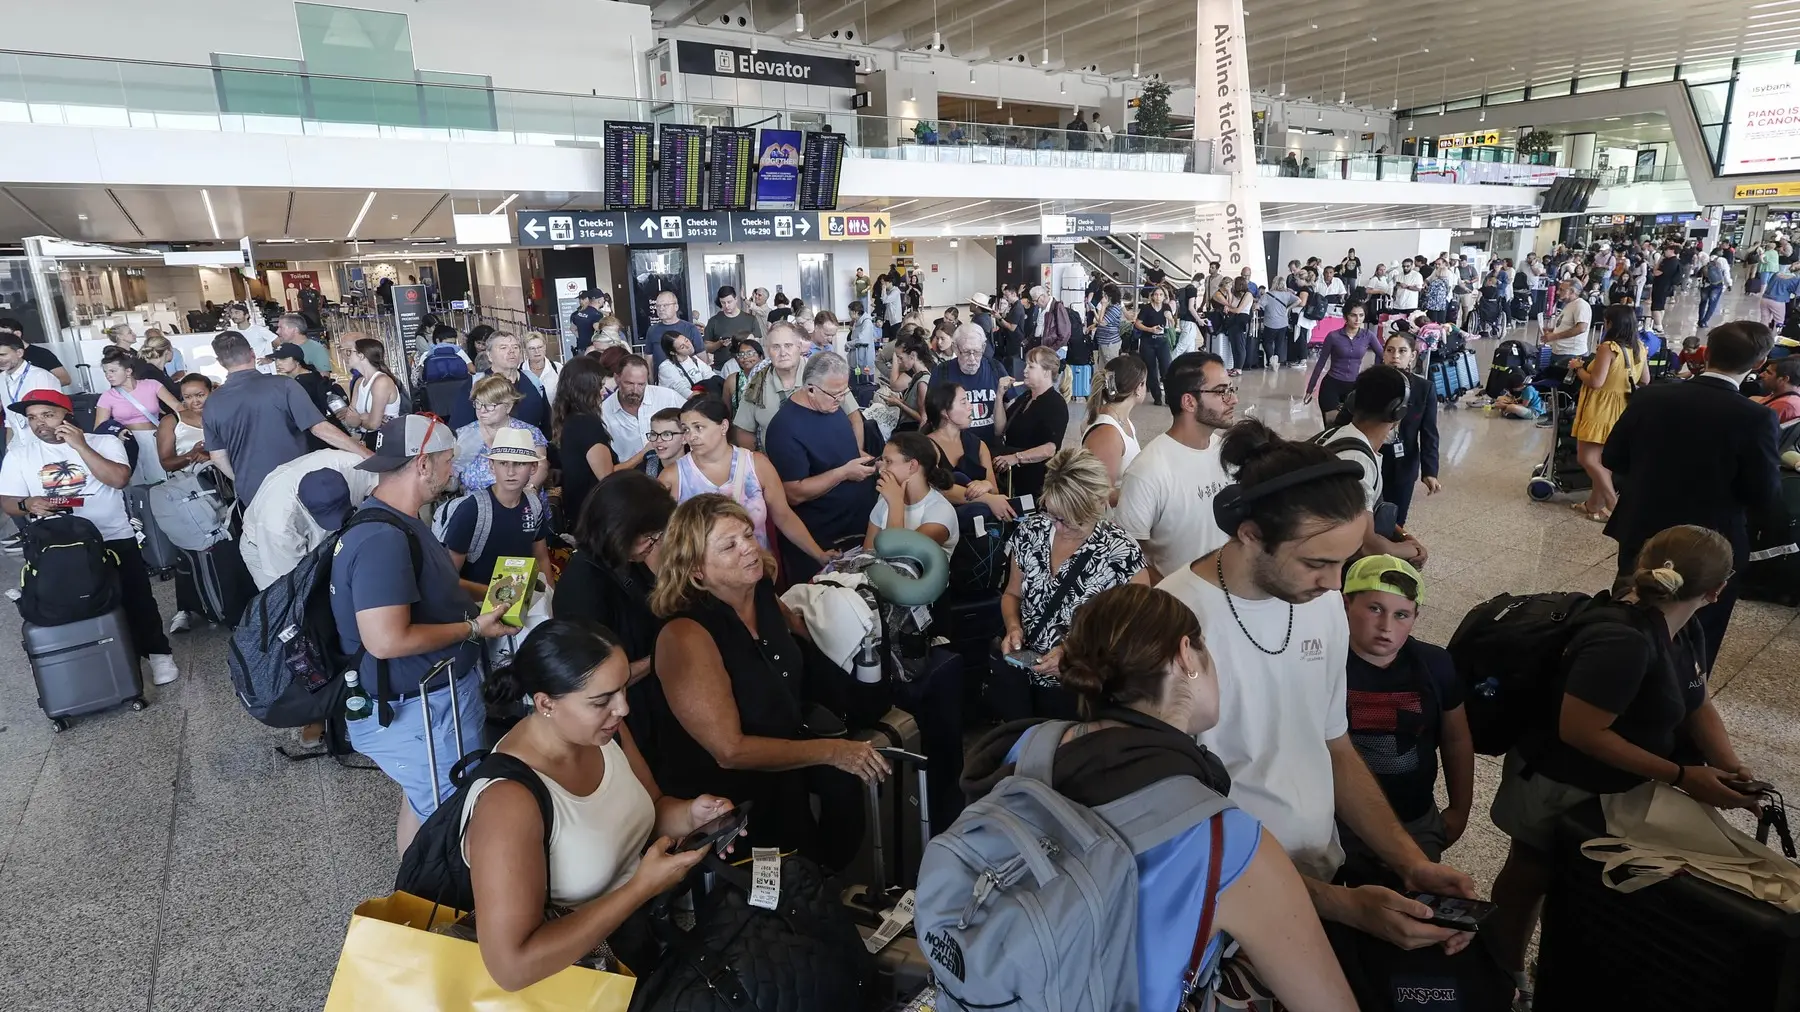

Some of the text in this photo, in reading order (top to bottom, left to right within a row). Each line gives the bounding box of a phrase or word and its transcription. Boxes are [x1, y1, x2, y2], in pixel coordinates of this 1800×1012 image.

[739, 54, 811, 79] Elevator
[1752, 82, 1792, 93] isybank
[1747, 108, 1785, 119] PIANO
[1214, 24, 1244, 264] Airline ticket office
[578, 218, 614, 227] Check-in
[686, 218, 718, 226] Check-in
[741, 218, 771, 226] Check-in
[580, 229, 613, 238] 316-445
[687, 228, 717, 236] 301-312
[743, 227, 771, 235] 146-290
[965, 389, 997, 402] OMA
[943, 929, 957, 950] THE
[924, 931, 955, 960] NORTH
[930, 947, 954, 972] FACE
[1397, 987, 1456, 1004] JANSPORT
